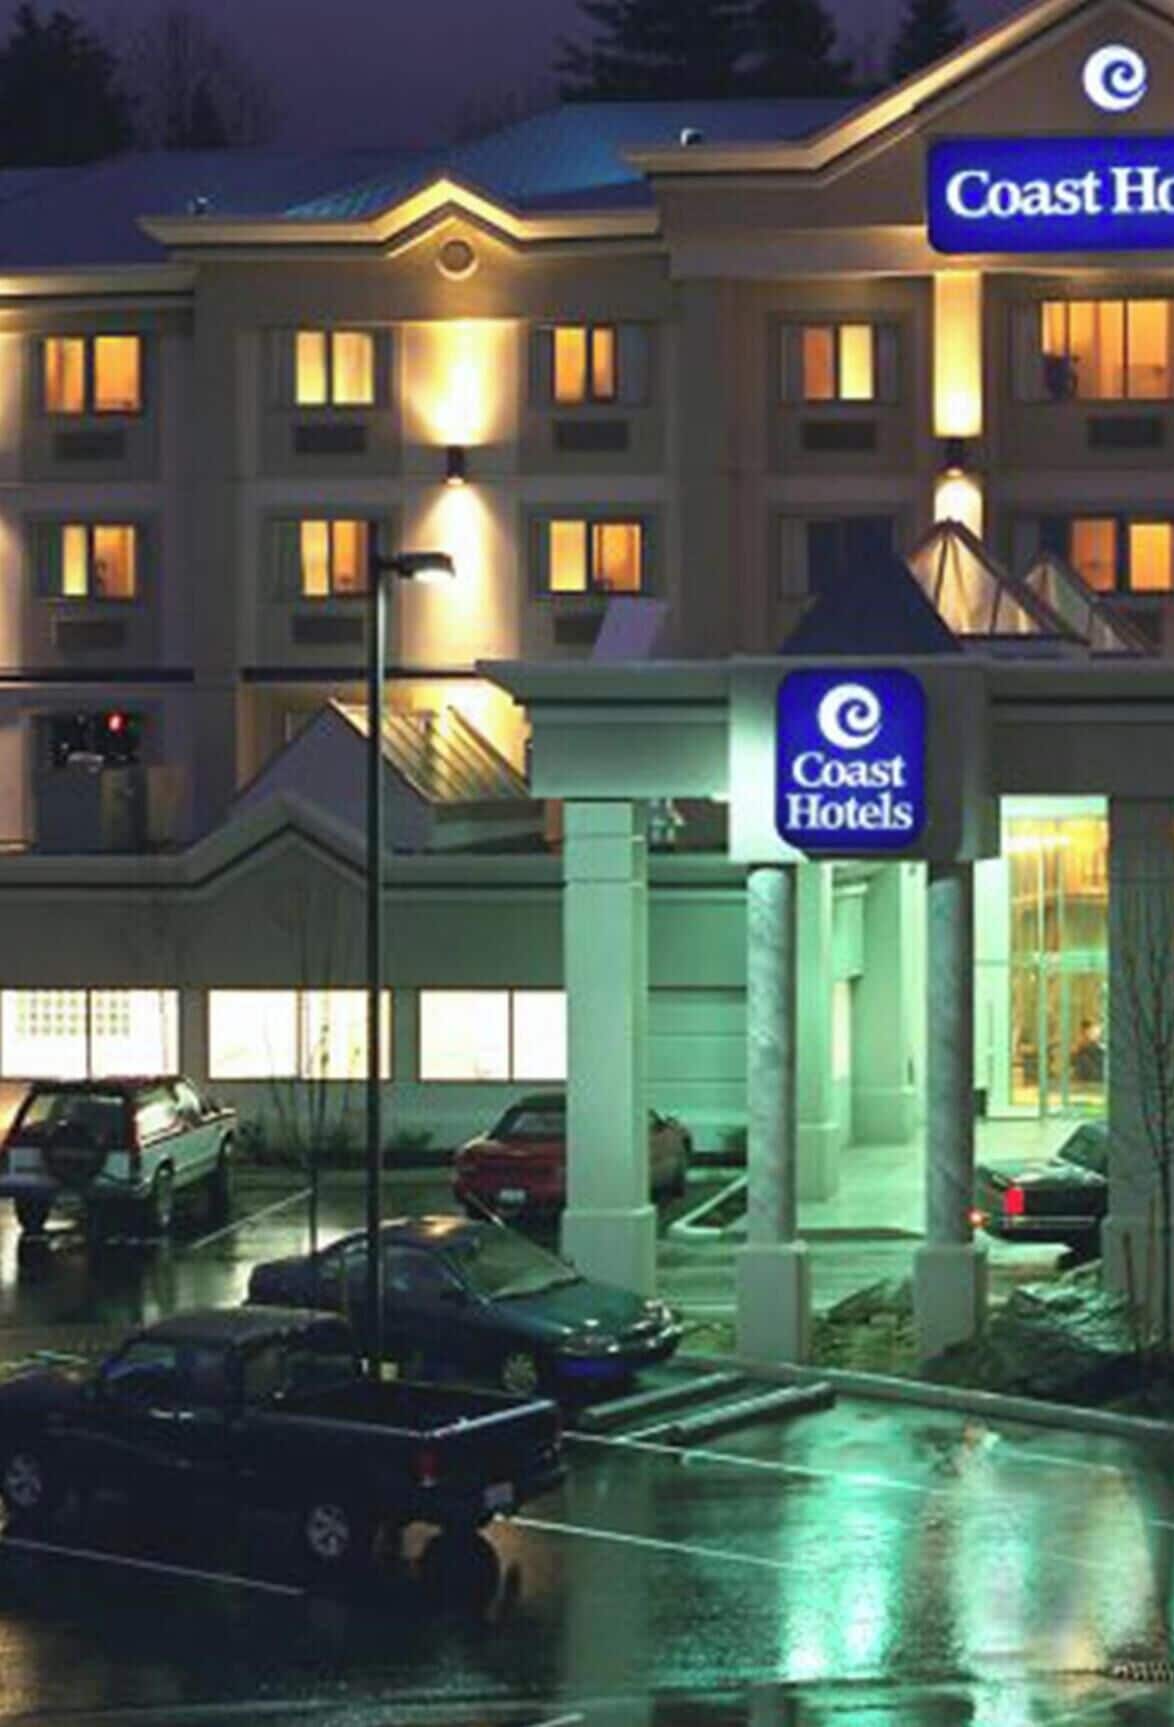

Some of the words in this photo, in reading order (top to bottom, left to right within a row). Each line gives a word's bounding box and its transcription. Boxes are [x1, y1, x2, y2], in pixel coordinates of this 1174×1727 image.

[945, 169, 1102, 219] Coast
[791, 751, 906, 788] Coast
[786, 791, 914, 830] Hotels
